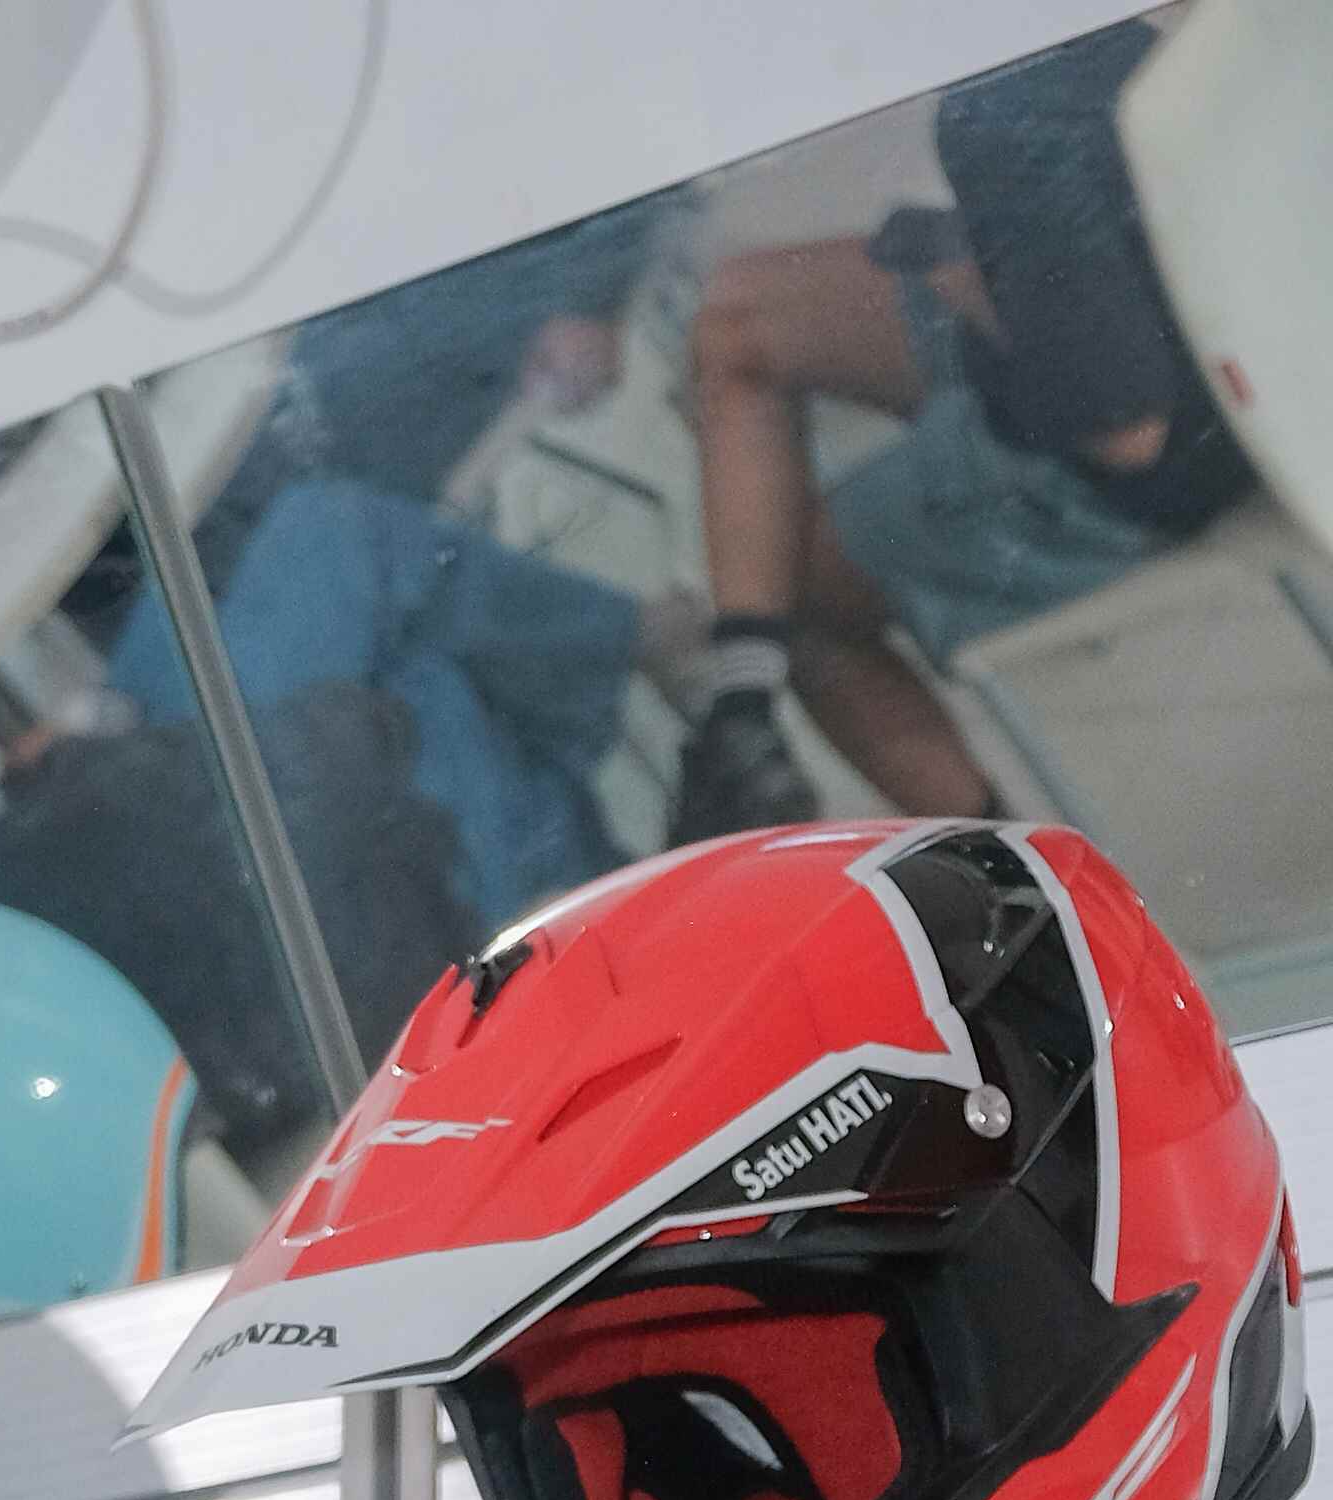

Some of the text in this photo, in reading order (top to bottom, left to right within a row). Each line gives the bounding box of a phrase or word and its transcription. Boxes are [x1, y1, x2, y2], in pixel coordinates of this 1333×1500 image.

[731, 1073, 893, 1201] Satu HATI.
[191, 1322, 339, 1374] HONDA
